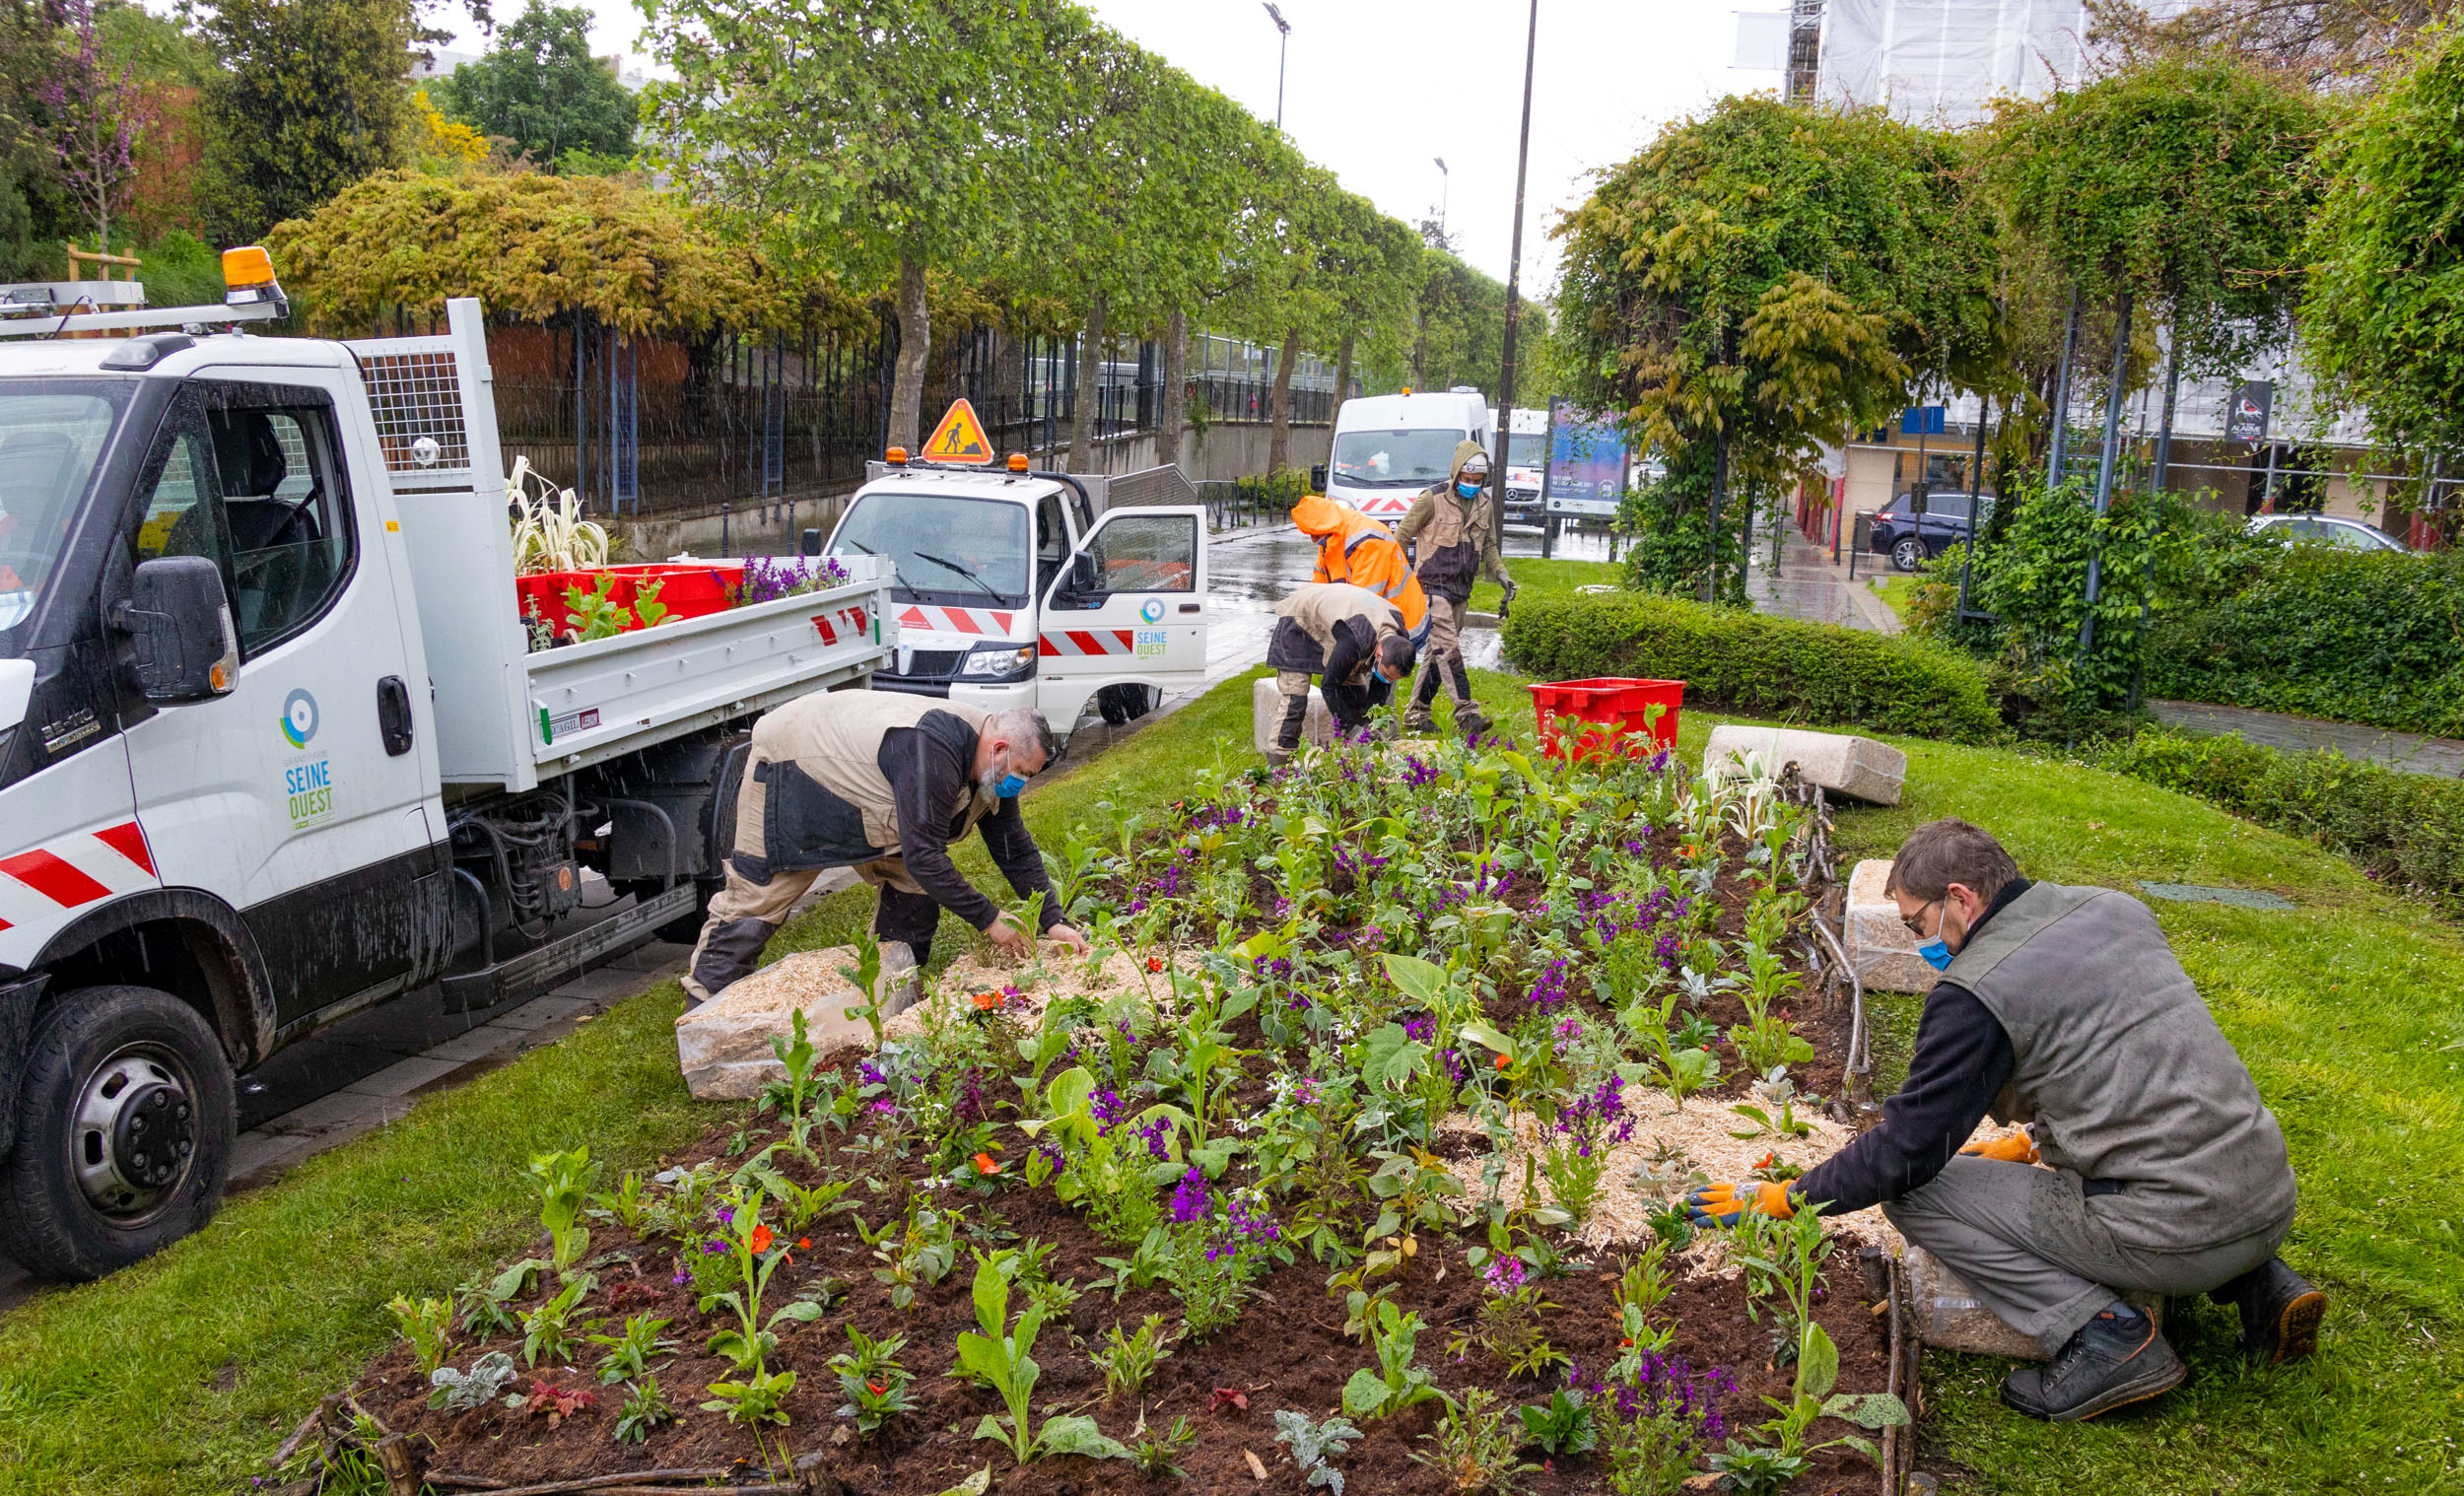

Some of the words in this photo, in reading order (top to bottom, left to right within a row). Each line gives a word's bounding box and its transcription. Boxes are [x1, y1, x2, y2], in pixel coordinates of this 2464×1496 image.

[1506, 473, 1539, 482] dEx
[1137, 632, 1167, 644] SEINE
[1137, 644, 1167, 655] OUEST
[550, 718, 580, 735] CAGIL
[286, 761, 331, 795] SEINE
[290, 787, 331, 820] OUEST
